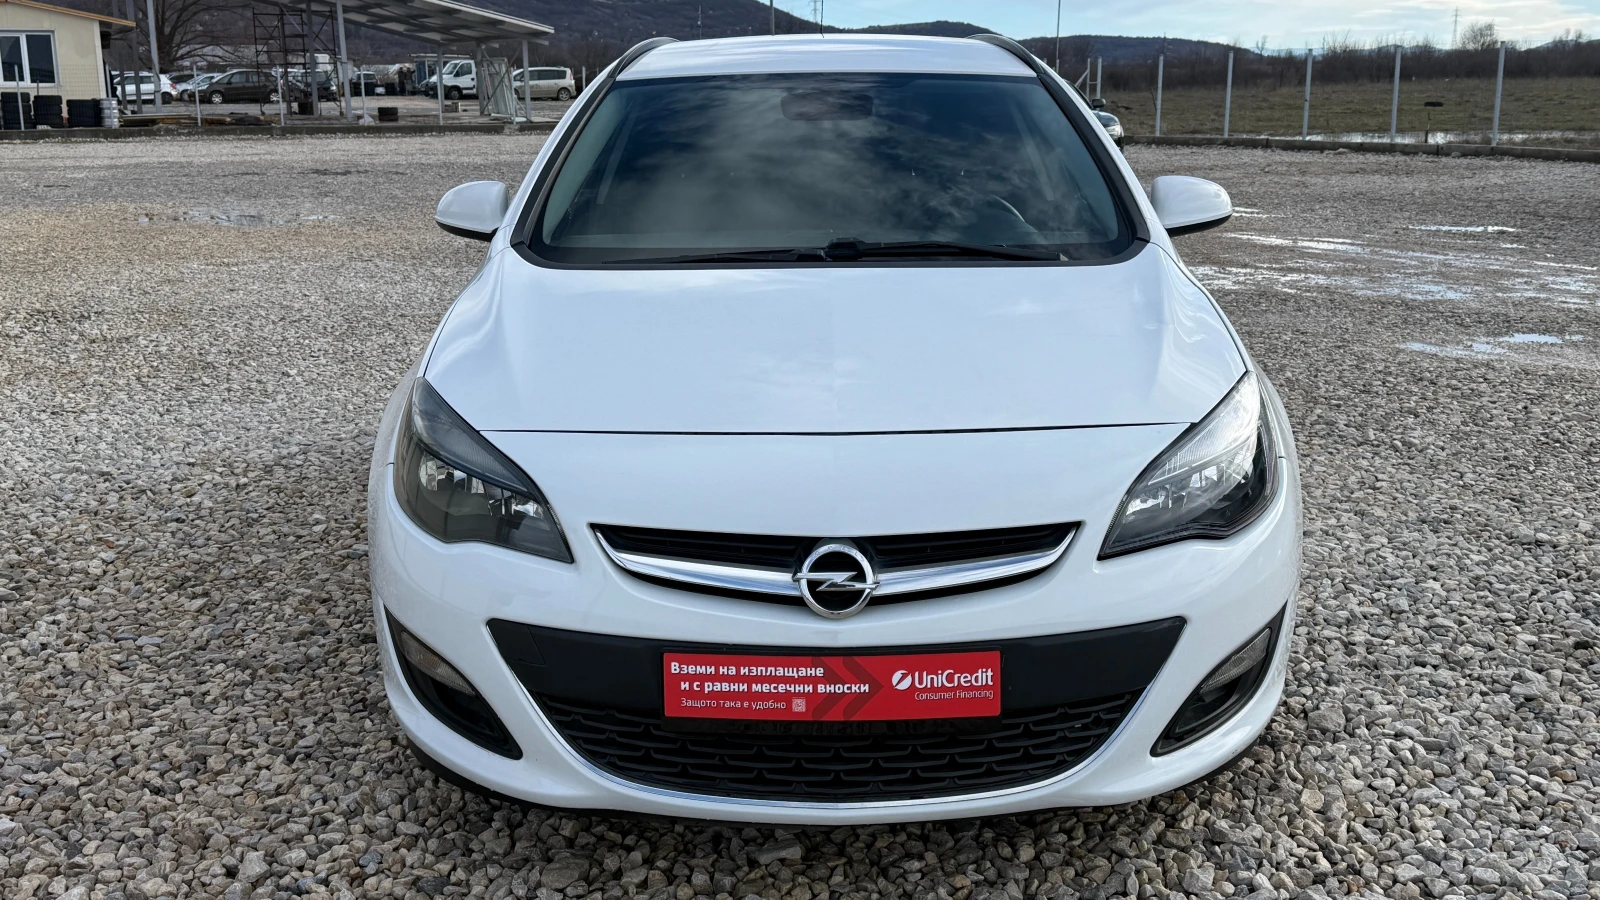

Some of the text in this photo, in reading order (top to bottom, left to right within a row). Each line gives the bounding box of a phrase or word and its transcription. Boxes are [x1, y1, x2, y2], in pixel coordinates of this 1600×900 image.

[670, 661, 824, 678] Вземи на изплащане
[914, 667, 994, 689] UniCredit
[680, 681, 869, 694] и с равни месечни вноски
[914, 689, 994, 701] Consumer Financing
[680, 697, 786, 711] Защото така е удобно
